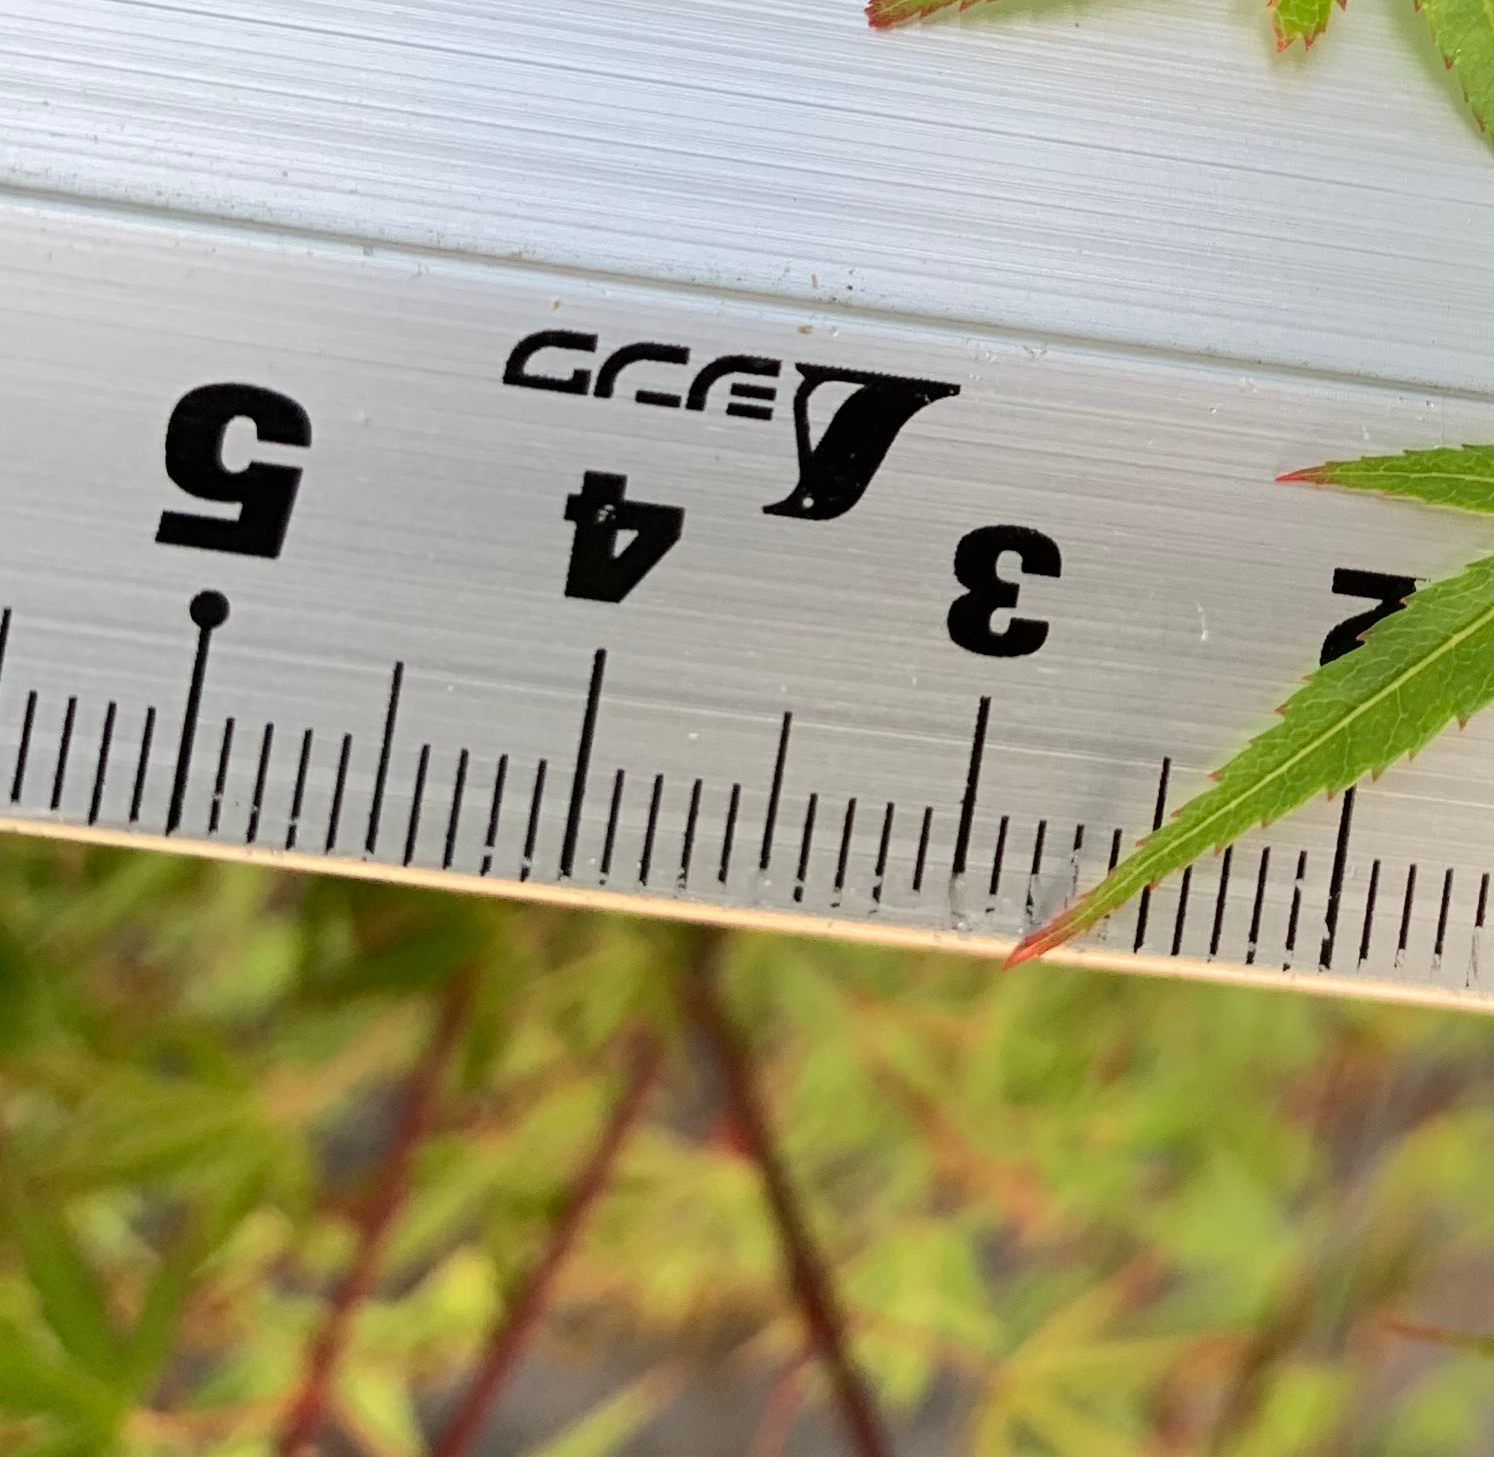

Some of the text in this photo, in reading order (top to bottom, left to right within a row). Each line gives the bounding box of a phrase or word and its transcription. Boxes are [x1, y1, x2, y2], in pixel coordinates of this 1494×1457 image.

[502, 330, 781, 421] シンワ
[154, 383, 311, 560] 5
[563, 470, 685, 604] 4
[946, 524, 1062, 658] 3
